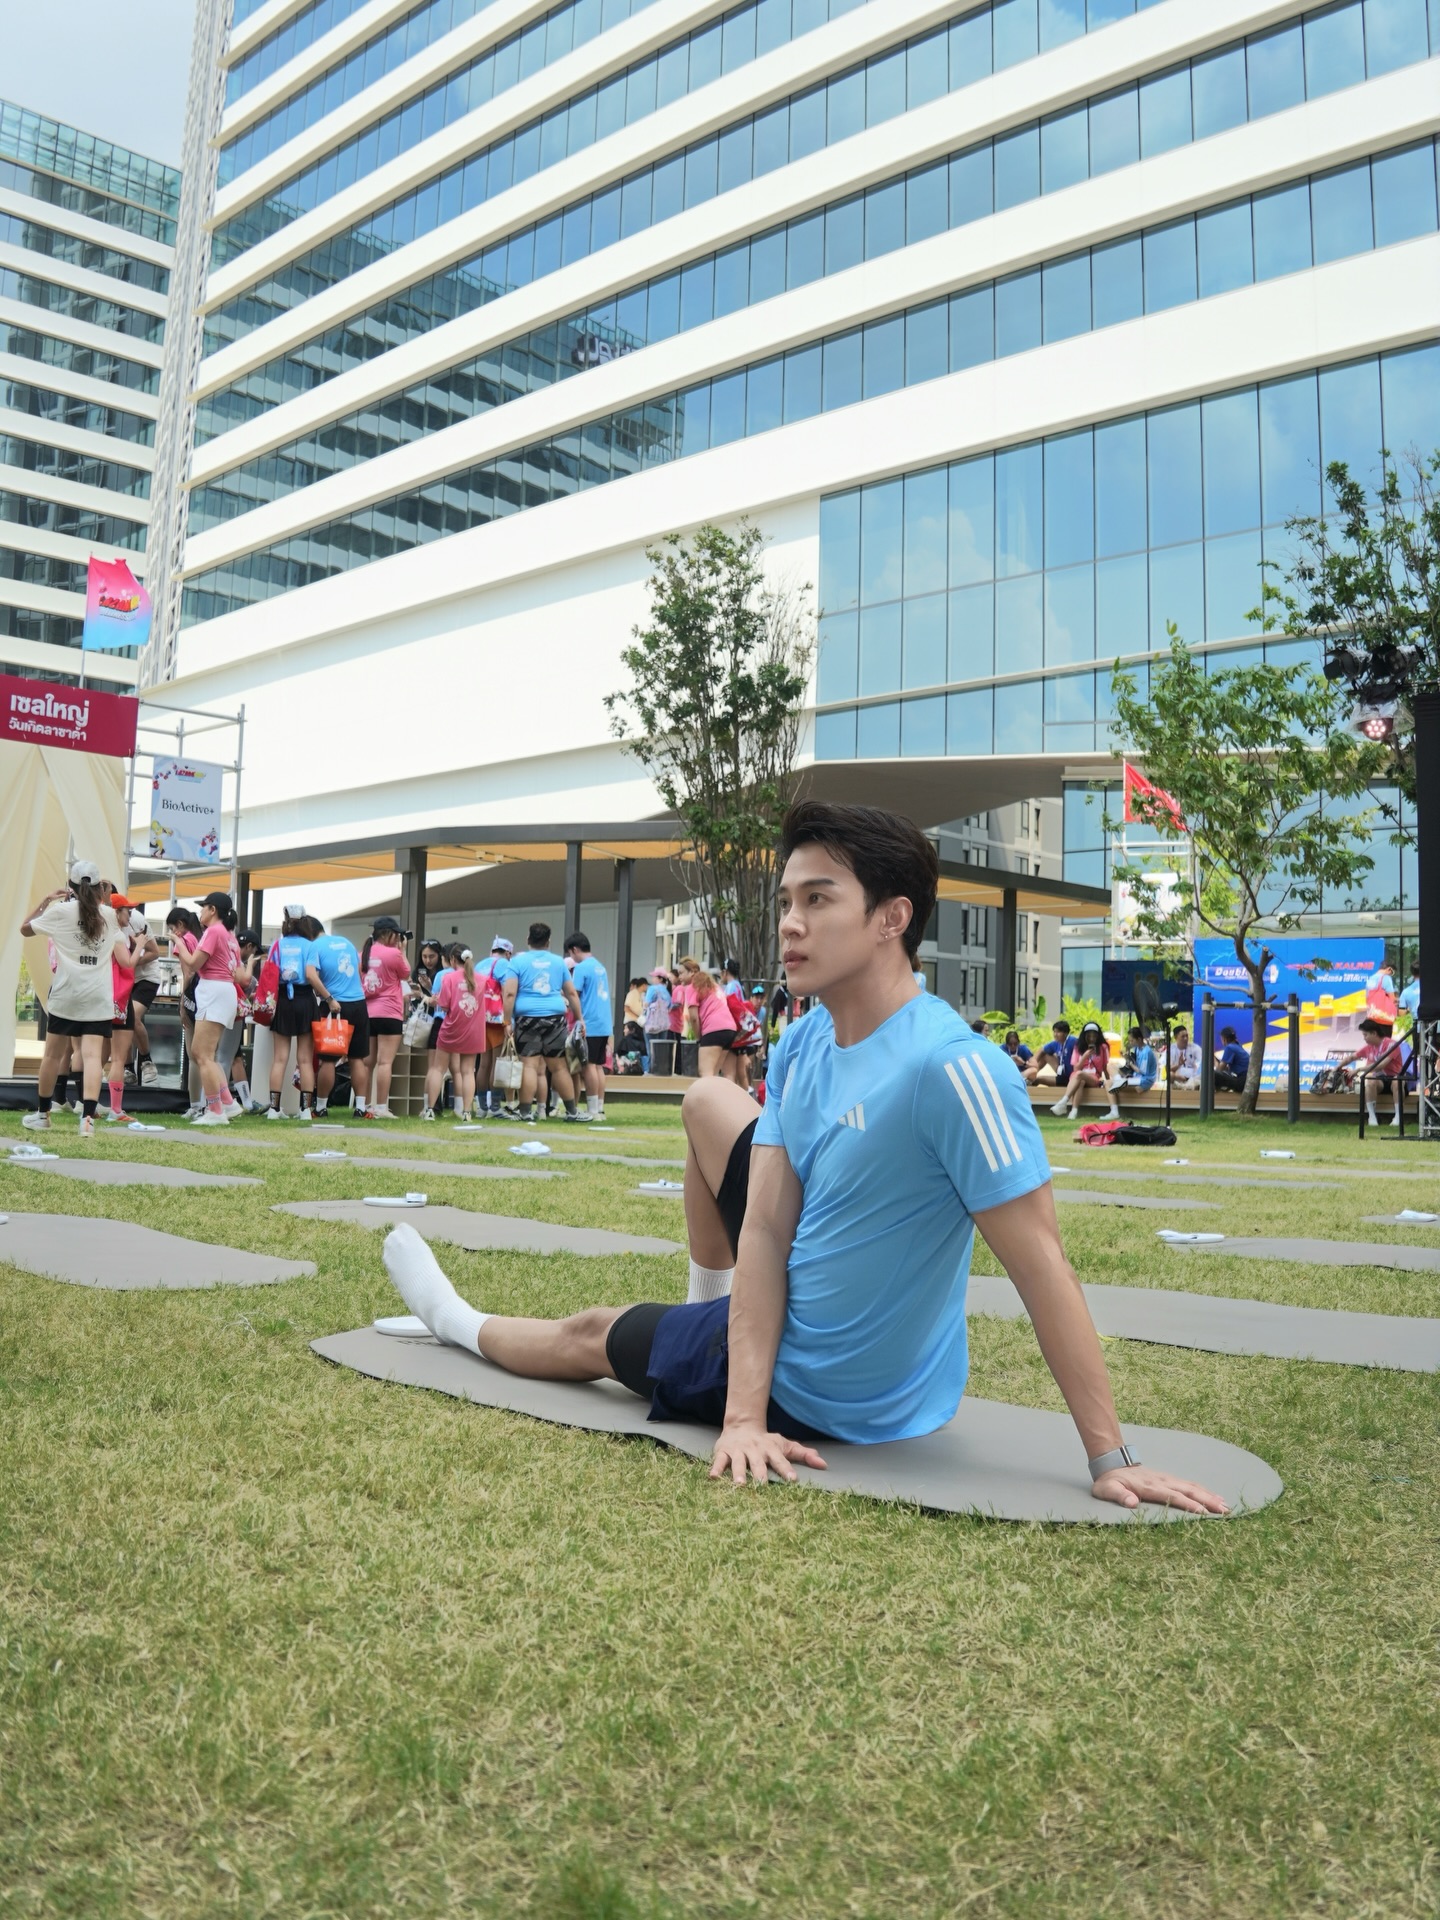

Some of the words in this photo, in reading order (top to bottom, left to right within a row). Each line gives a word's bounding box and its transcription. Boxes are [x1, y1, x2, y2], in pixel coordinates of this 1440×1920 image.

[10, 693, 90, 728] เซลใหญ่
[8, 716, 87, 742] วันเกิดลาซาด้า
[161, 798, 215, 815] BioActive+
